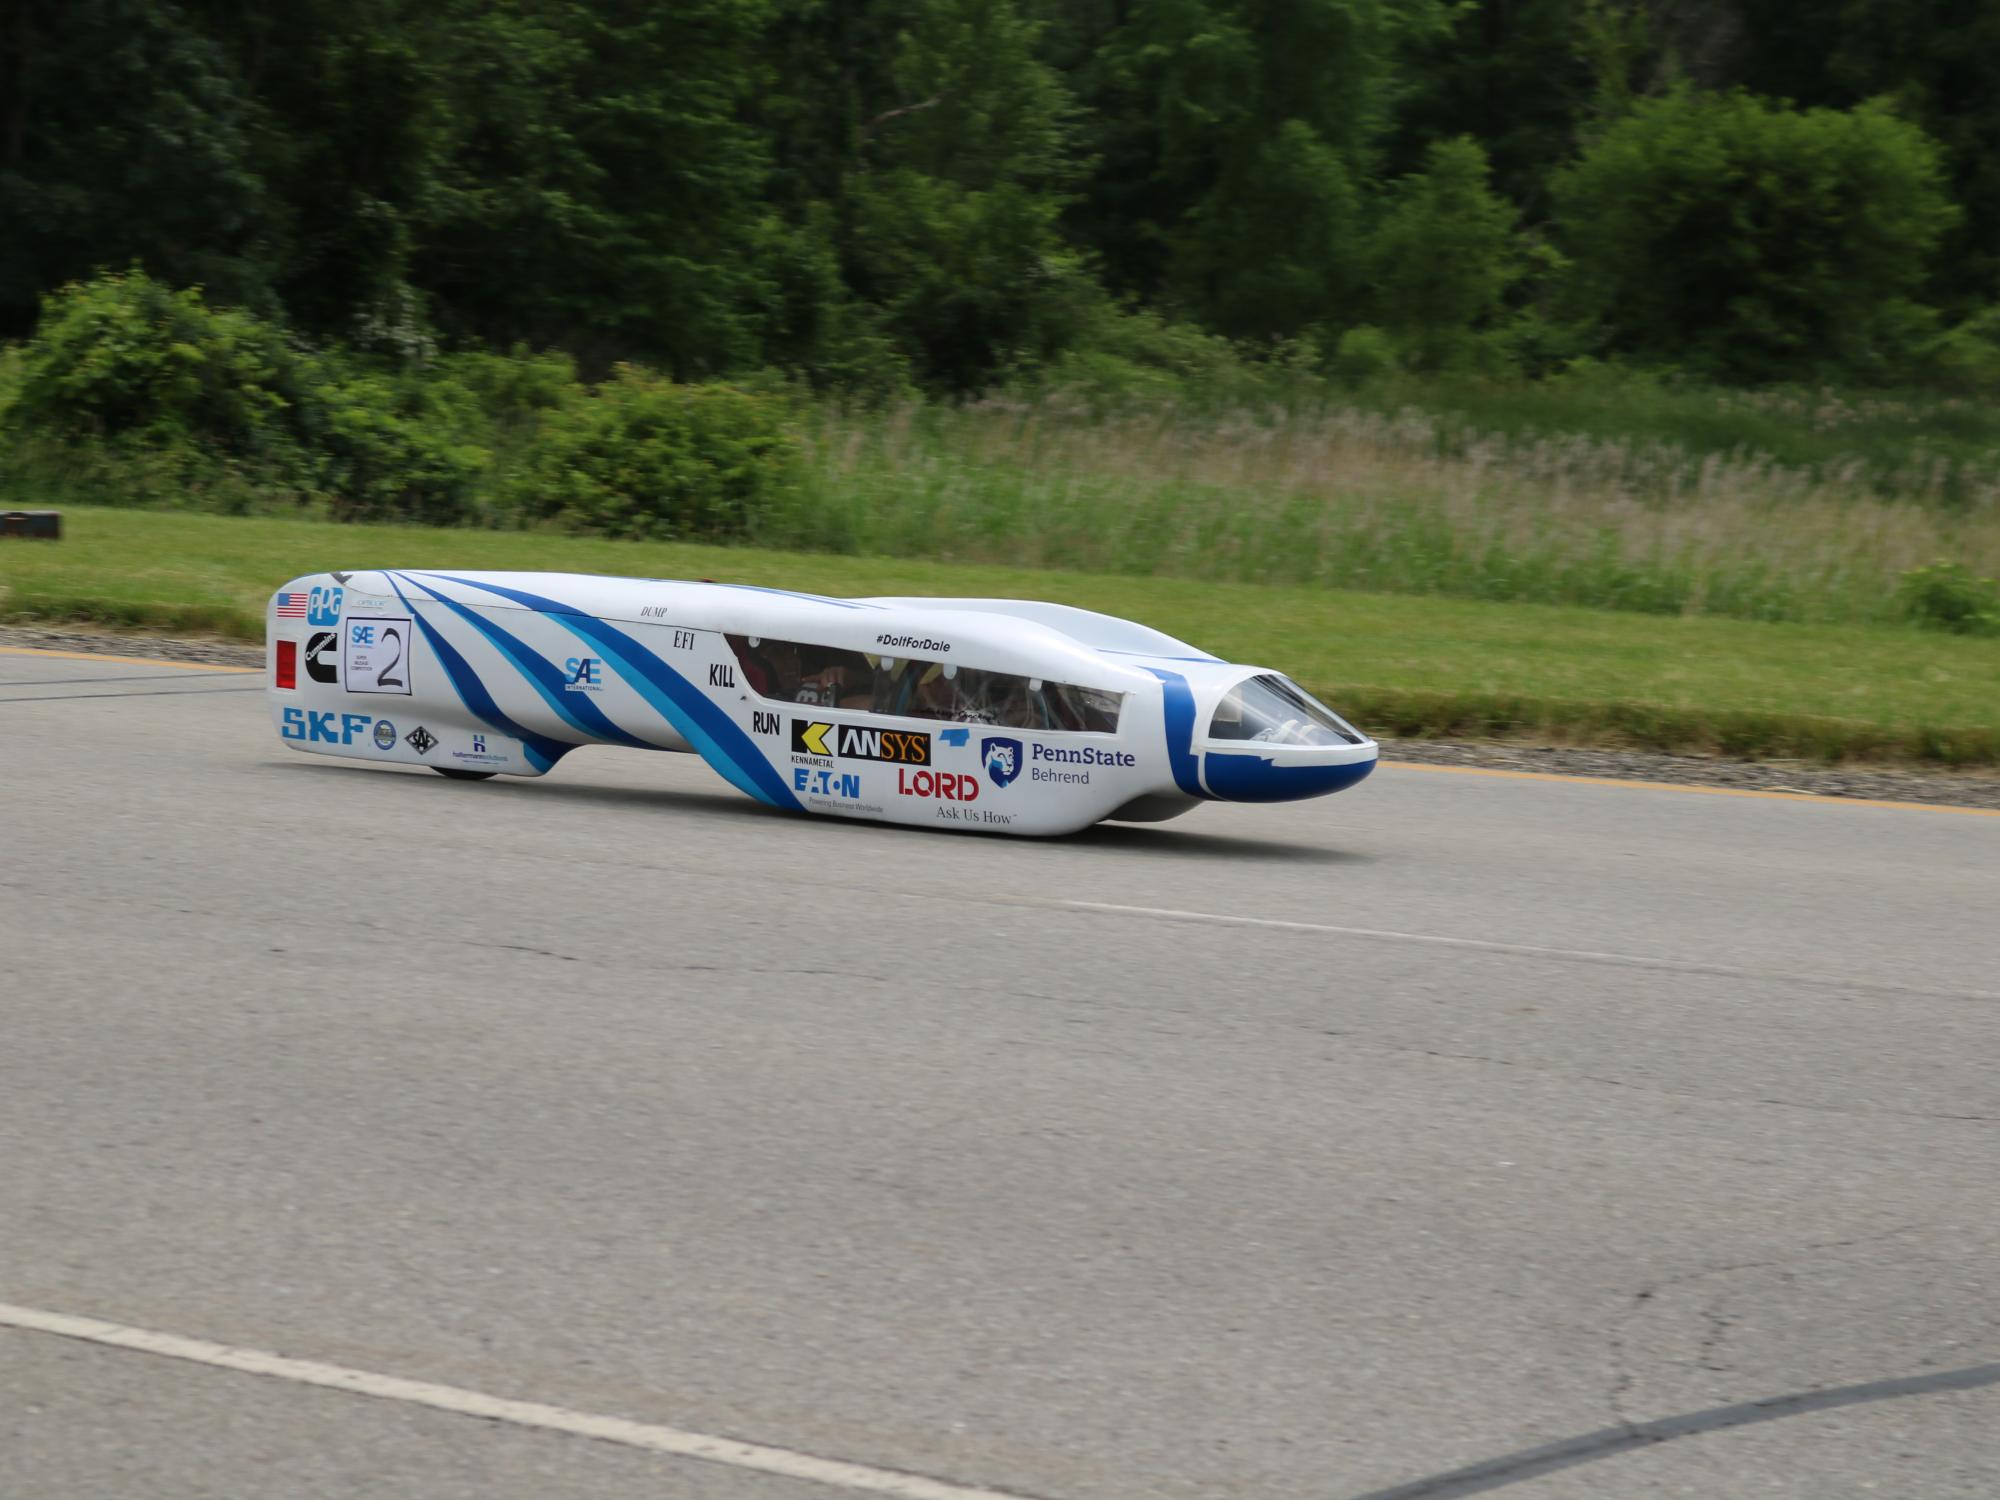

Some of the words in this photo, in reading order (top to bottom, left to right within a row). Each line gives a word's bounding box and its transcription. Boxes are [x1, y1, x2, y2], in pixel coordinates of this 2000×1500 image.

[309, 588, 341, 619] PPG
[640, 606, 667, 618] DUMP
[305, 632, 336, 661] Cummins
[352, 626, 375, 644] SAE
[673, 630, 696, 650] EFI
[876, 634, 951, 652] #DoItForDale
[377, 627, 403, 687] 2
[565, 657, 602, 684] SAE
[709, 663, 735, 688] KILL
[282, 707, 372, 745] SKF
[753, 711, 780, 736] RUN
[841, 728, 928, 762] ANSYS
[1032, 743, 1135, 767] PennState
[791, 755, 834, 768] KENNAMETAL
[794, 768, 860, 799] EATON
[898, 768, 979, 802] LORD
[1032, 767, 1089, 784] Behrend
[936, 806, 959, 820] Ask
[964, 808, 980, 822] Us
